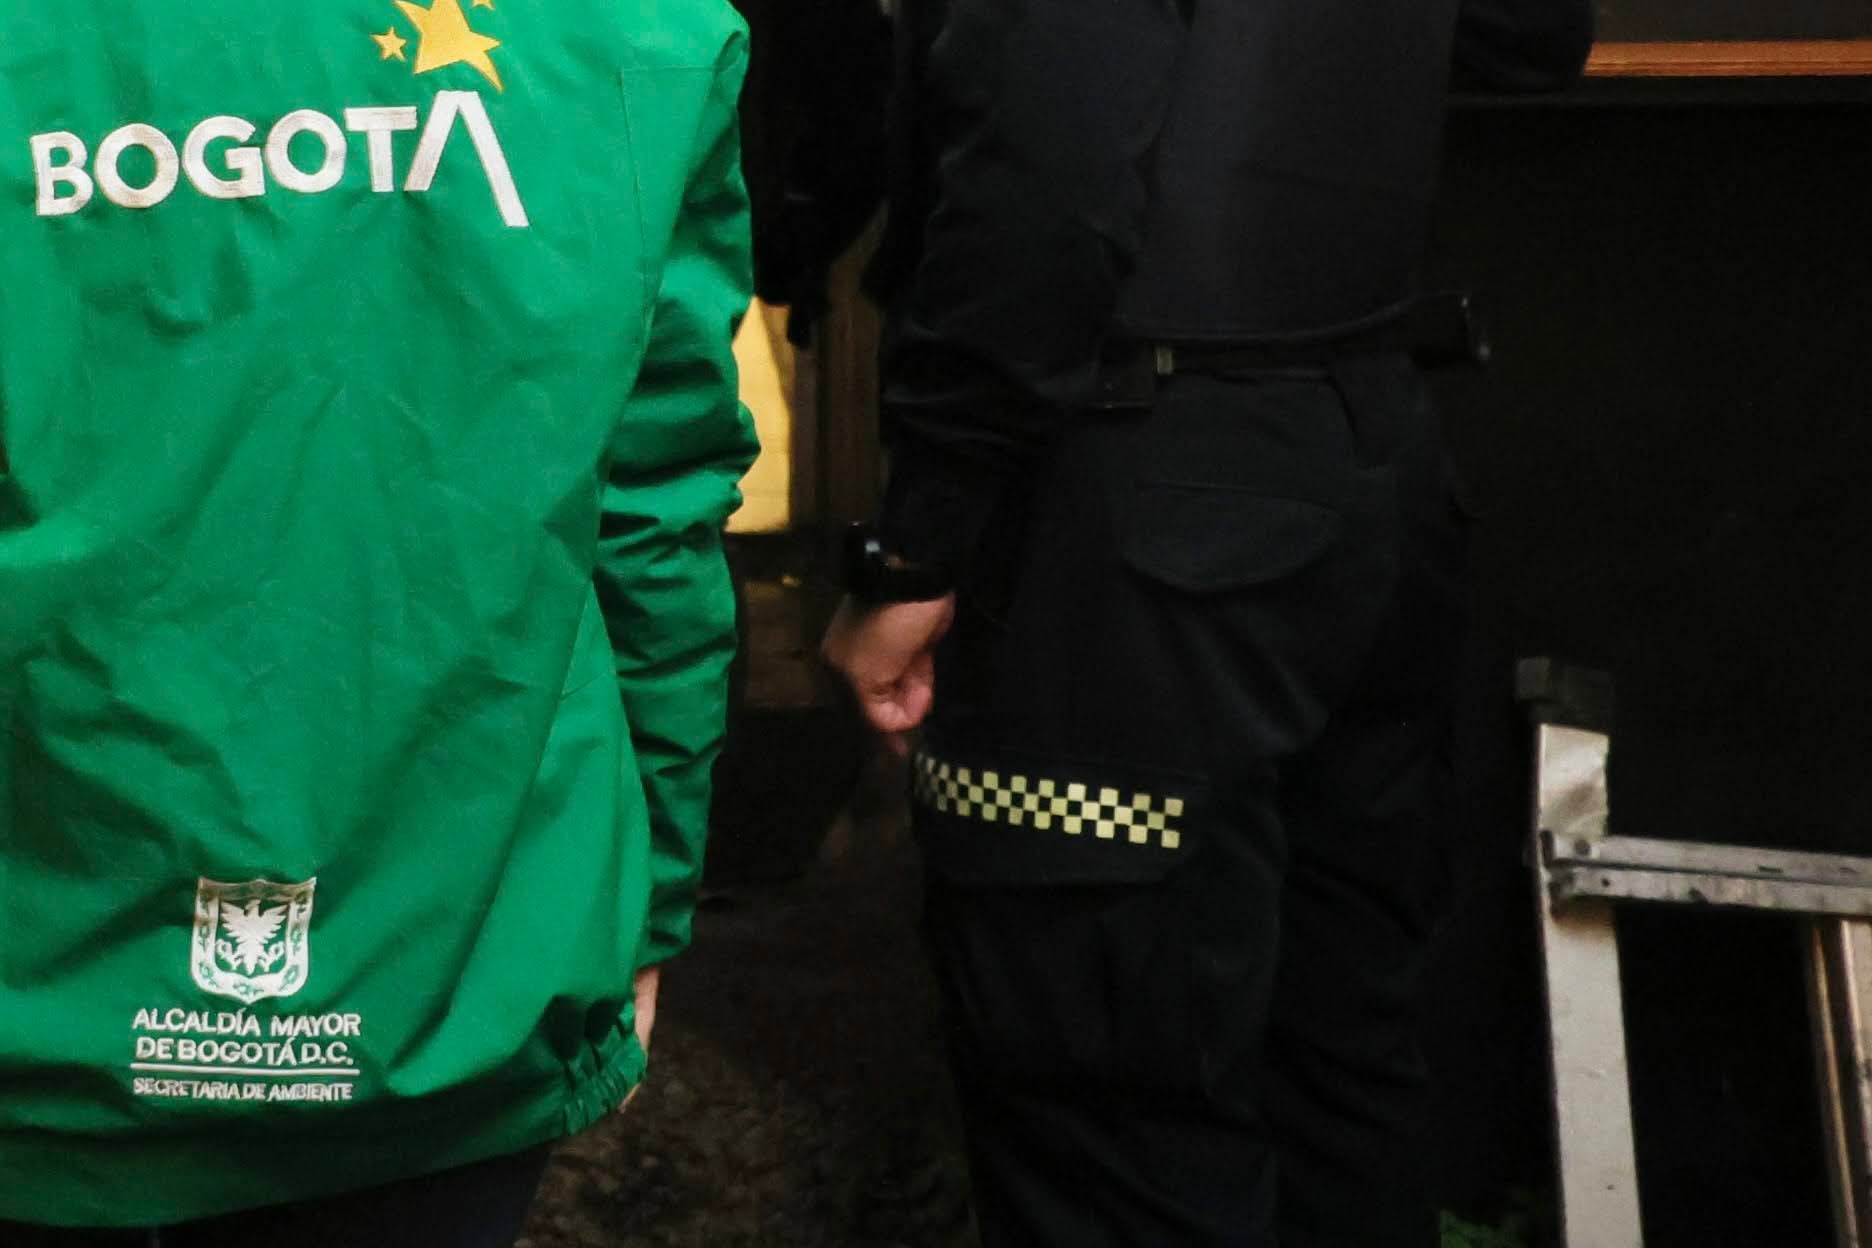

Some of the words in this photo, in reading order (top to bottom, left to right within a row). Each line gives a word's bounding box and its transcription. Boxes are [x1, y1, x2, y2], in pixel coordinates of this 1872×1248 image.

[132, 1007, 261, 1037] ALCALDÍA
[271, 1013, 361, 1037] MAYOR
[136, 1037, 174, 1060] DE
[178, 1036, 297, 1066] BOGOTÁ
[301, 1041, 354, 1066] D.C.
[241, 1083, 266, 1100] DE
[267, 1083, 353, 1102] AMBIENTE
